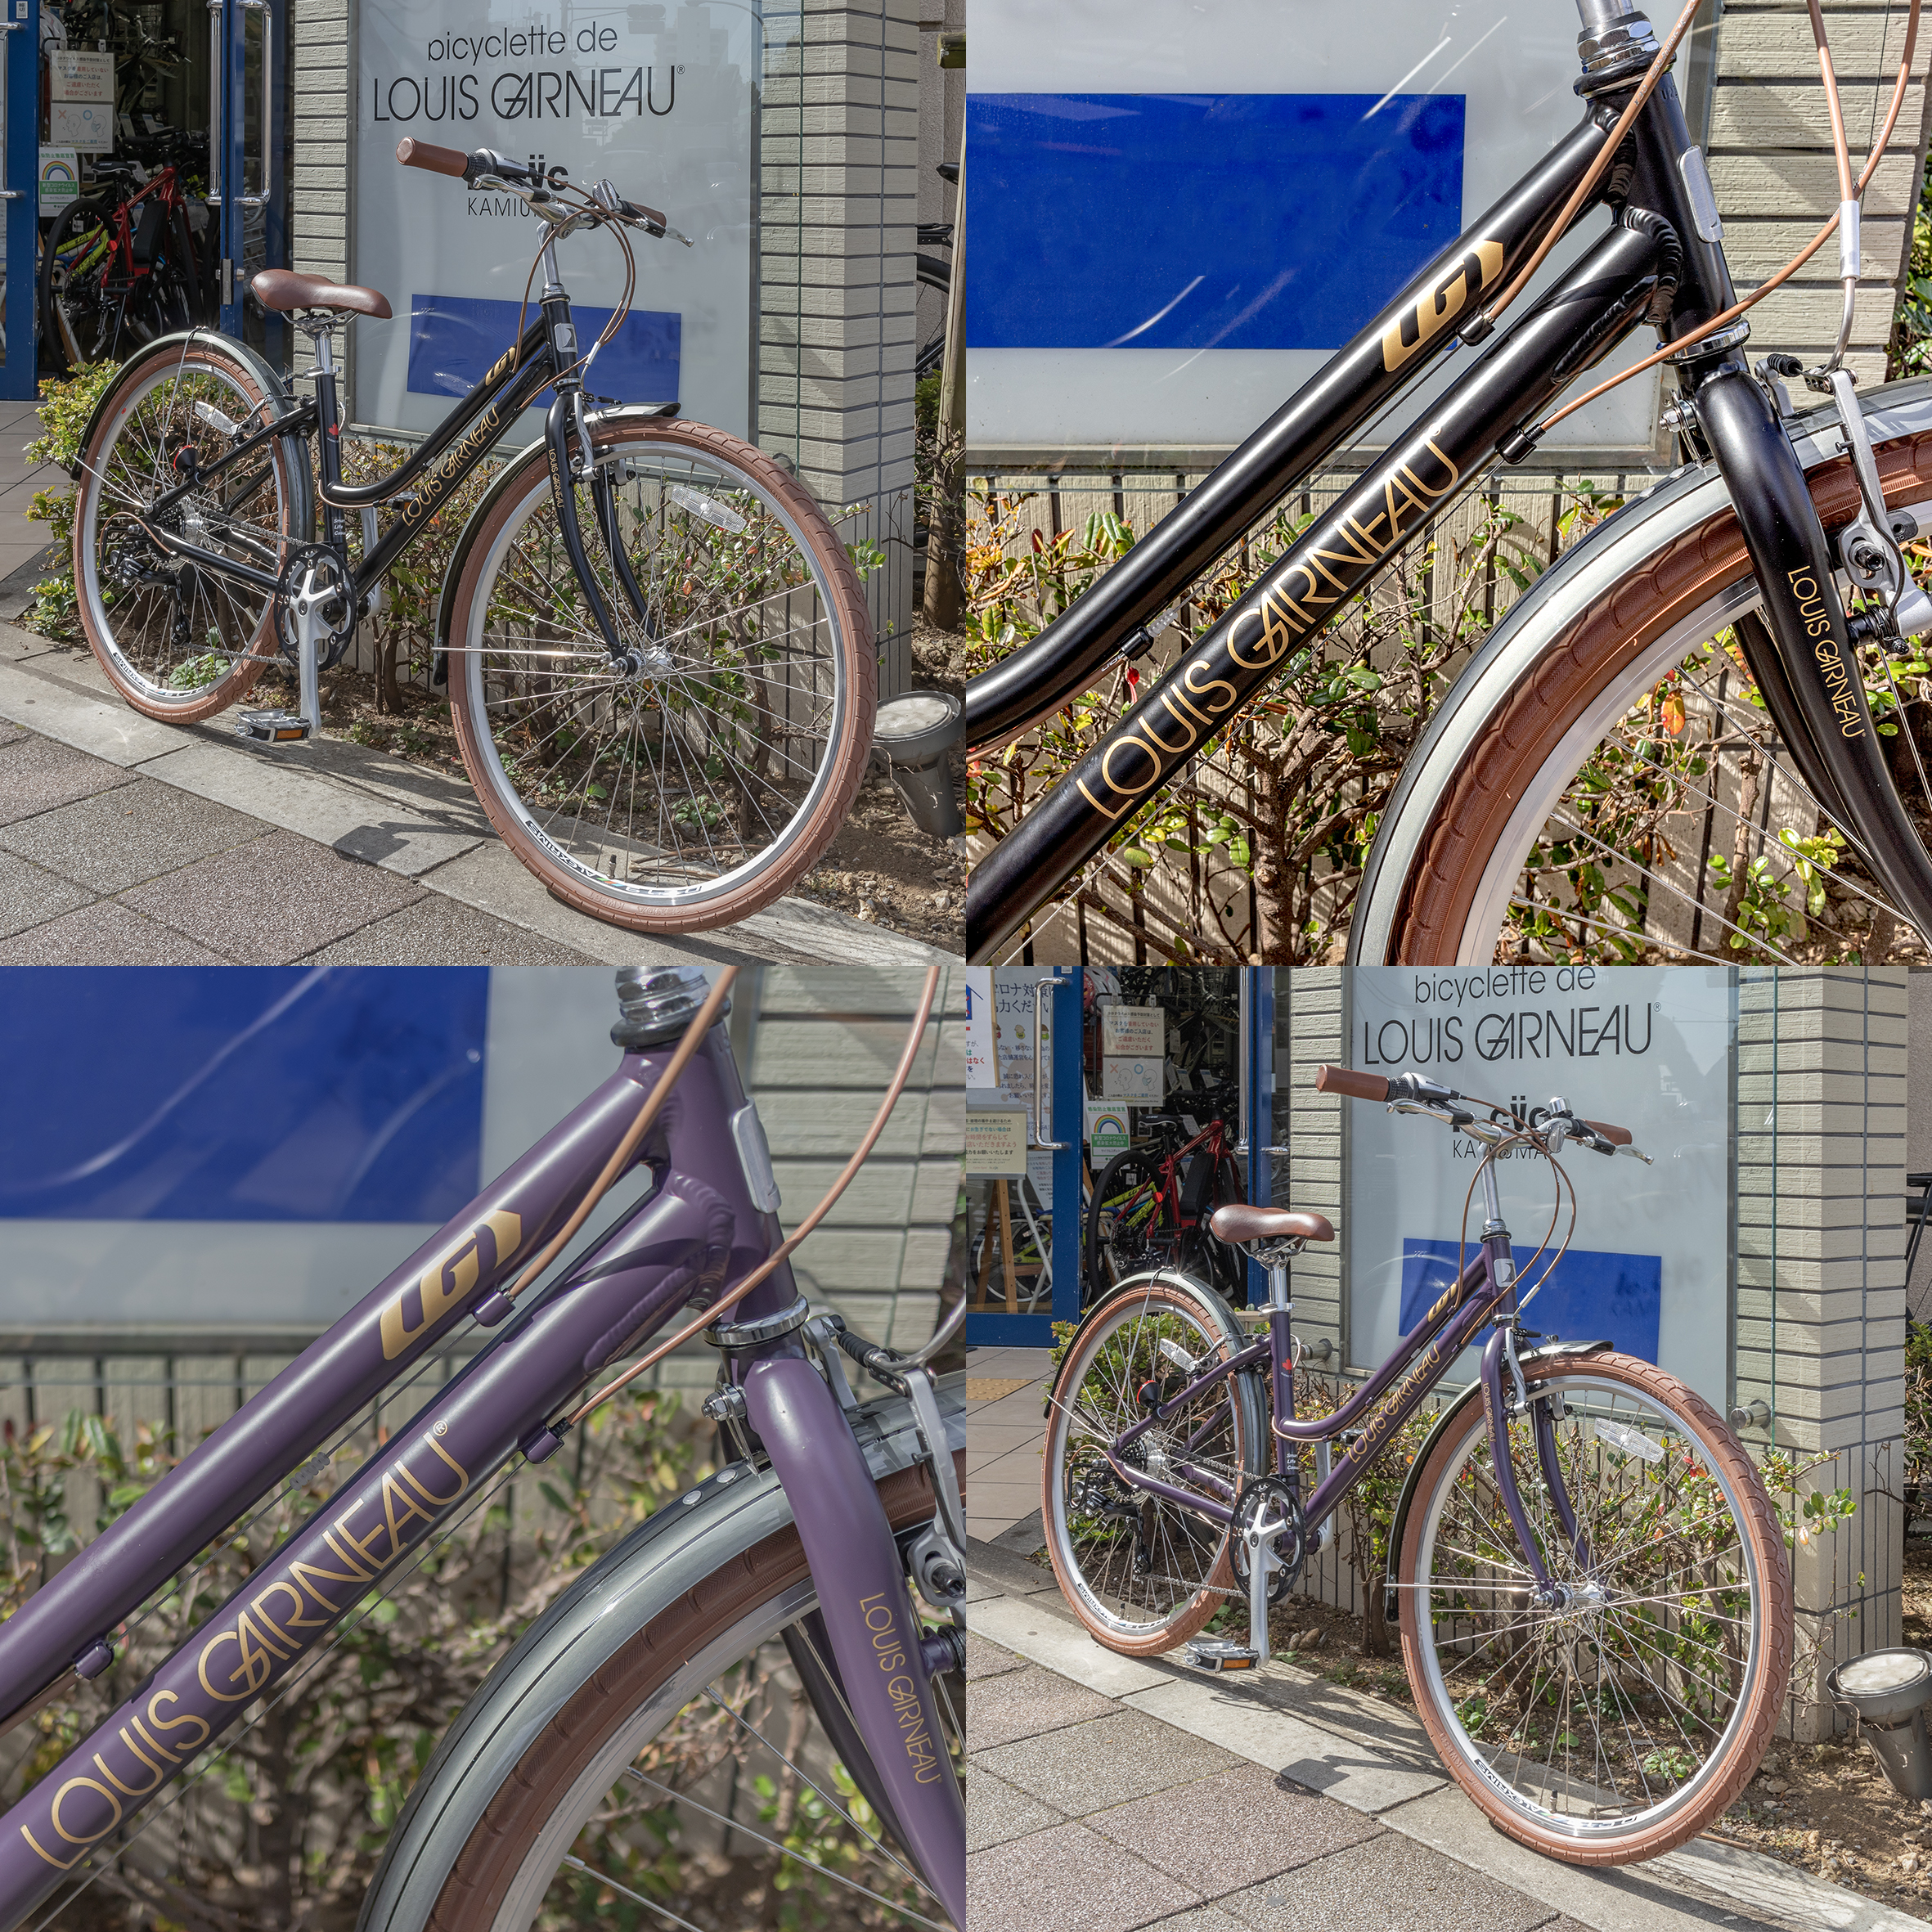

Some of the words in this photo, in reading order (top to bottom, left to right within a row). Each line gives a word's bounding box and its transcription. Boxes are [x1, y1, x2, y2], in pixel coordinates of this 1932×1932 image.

[577, 21, 618, 53] de
[374, 74, 479, 122] LOUIS
[468, 197, 540, 218] KAMIU
[548, 448, 559, 474] LOUIS
[402, 474, 443, 527] LOUIS
[1787, 564, 1831, 637] LOUIS
[1076, 659, 1238, 820] LOUIS
[528, 823, 594, 877] ALEXRIMS
[1414, 968, 1546, 1008] bicyclette
[1557, 966, 1596, 991] de
[1364, 1015, 1464, 1065] LOUIS
[1482, 1382, 1492, 1409] LOUIS
[1348, 1413, 1387, 1463] LOUIS
[859, 1592, 907, 1673] LOUIS
[20, 1690, 210, 1870] LOUIS
[1476, 1761, 1539, 1812] ALEXRIMS
